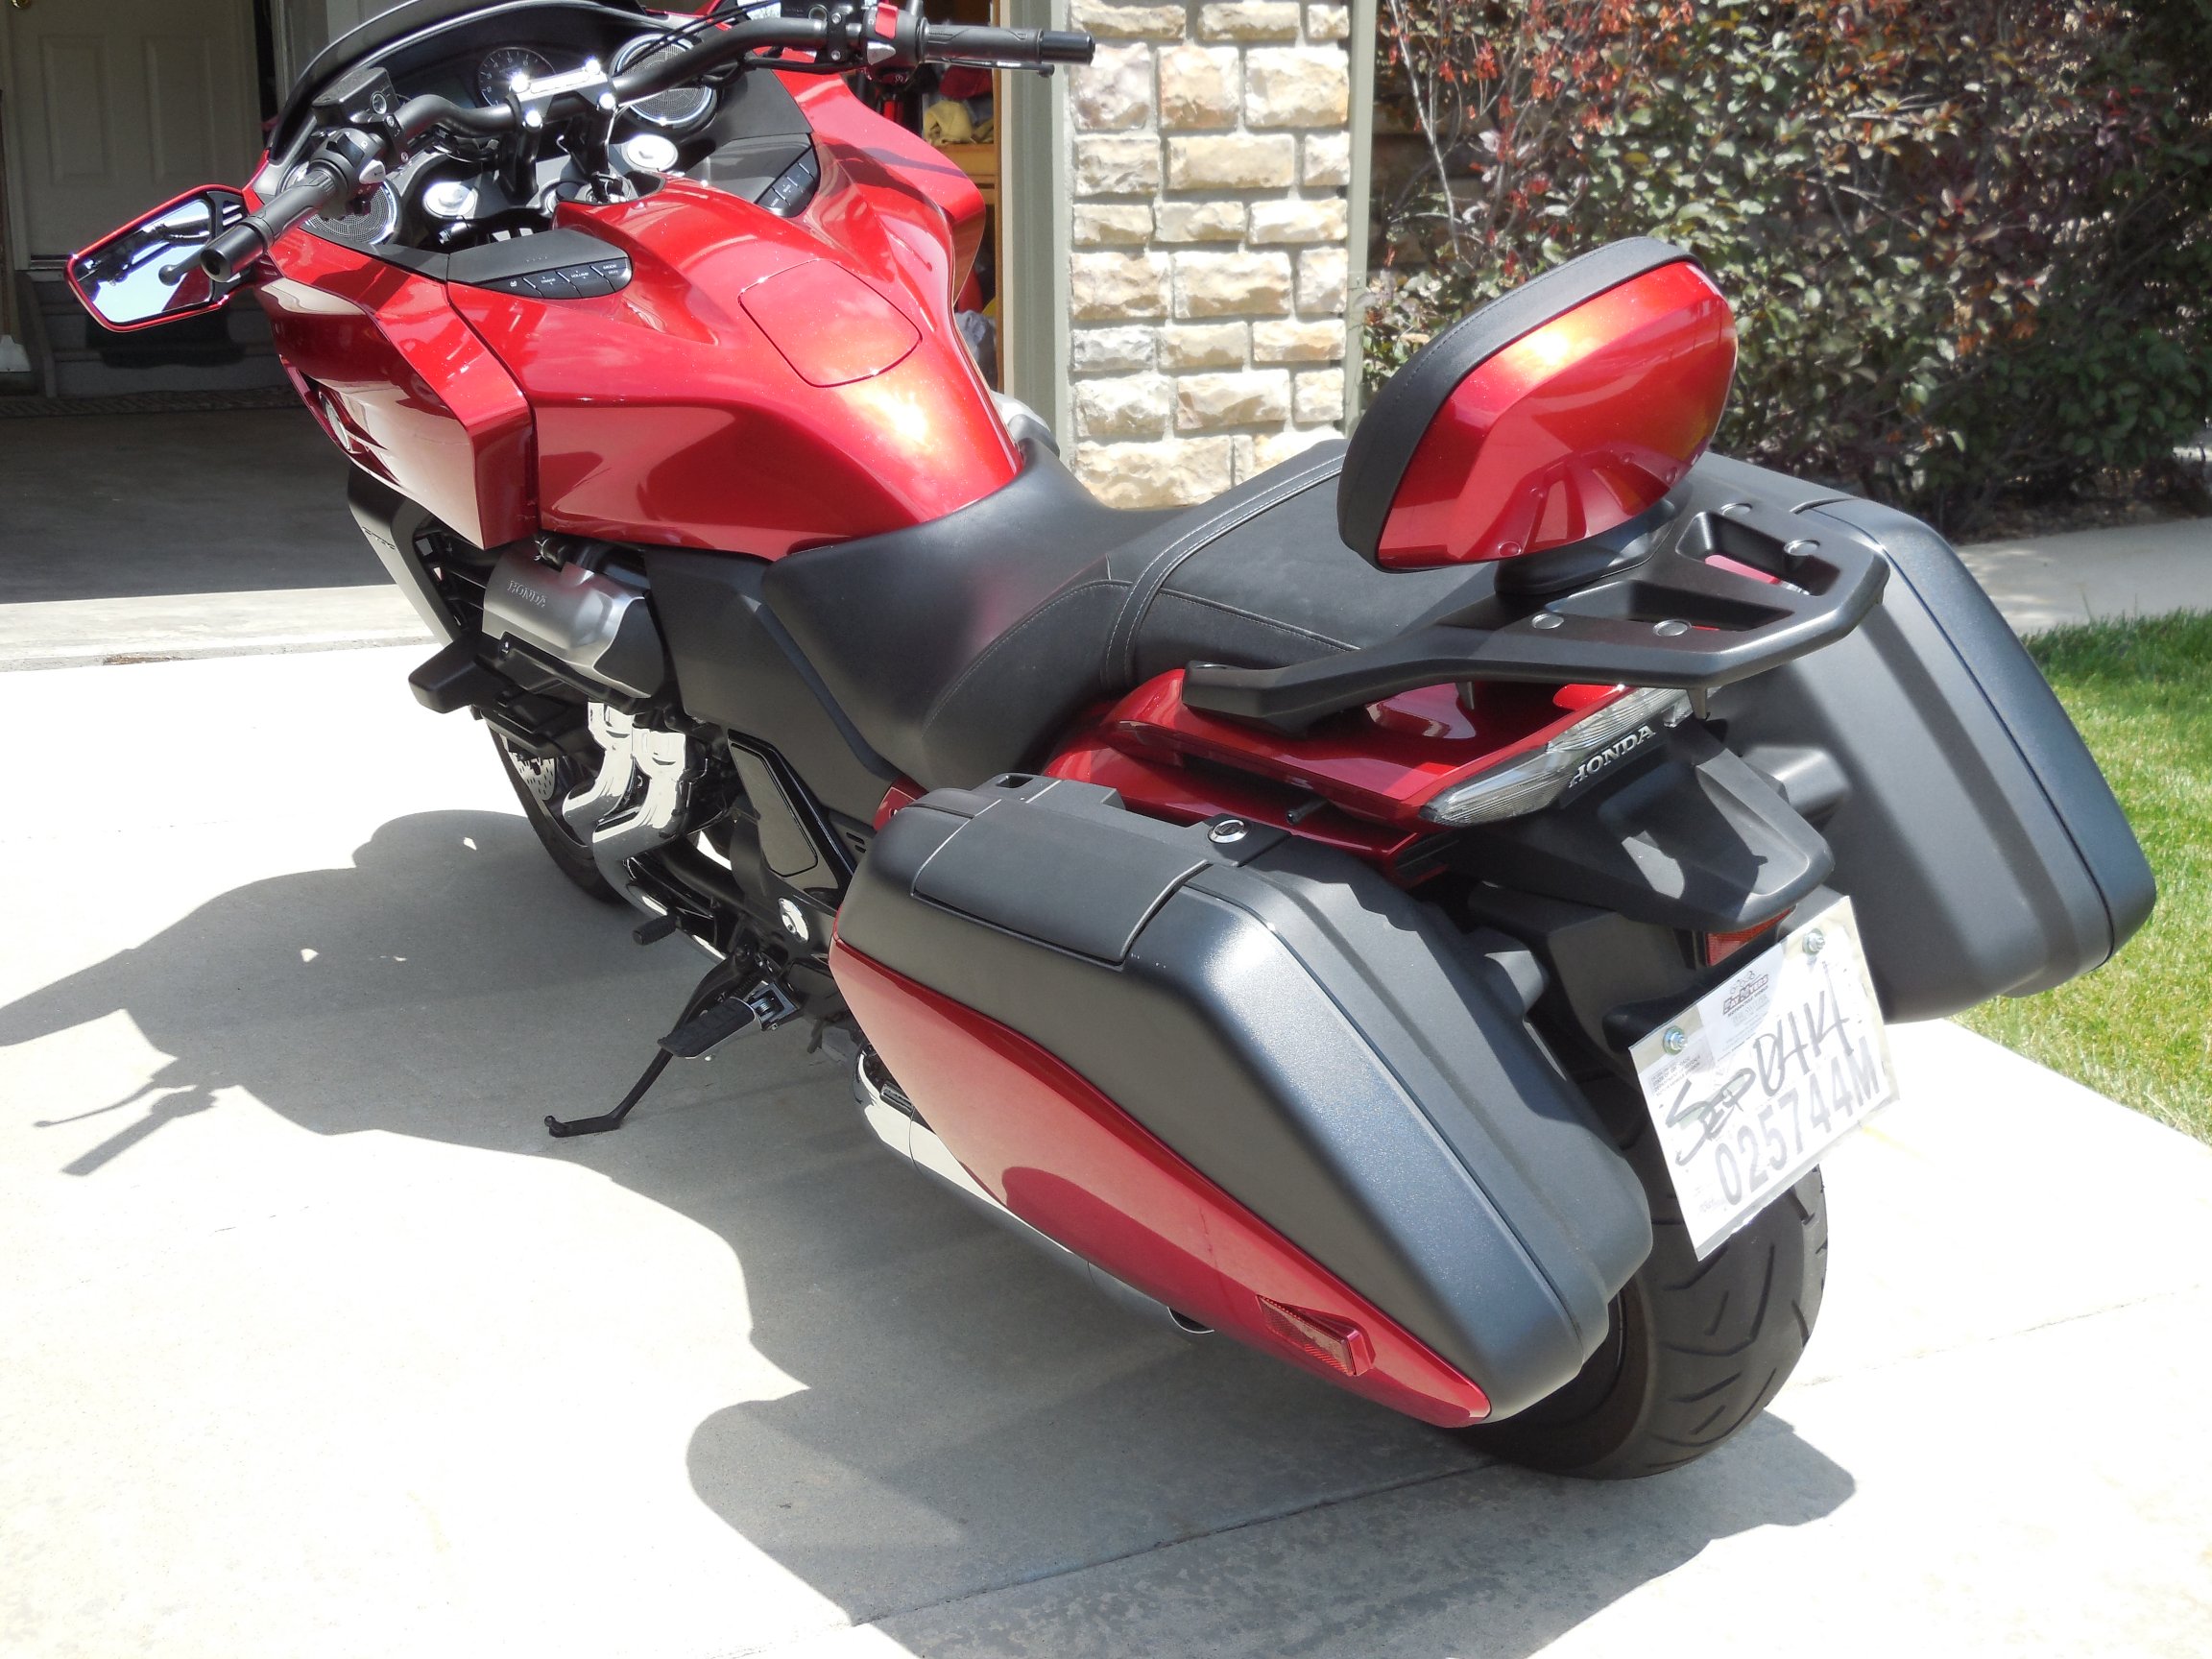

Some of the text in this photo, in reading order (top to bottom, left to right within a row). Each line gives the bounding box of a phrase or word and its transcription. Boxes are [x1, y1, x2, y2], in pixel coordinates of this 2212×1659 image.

[506, 580, 546, 608] HONDA
[1568, 725, 1656, 788] HONDA
[1715, 1035, 1880, 1205] 025744M
